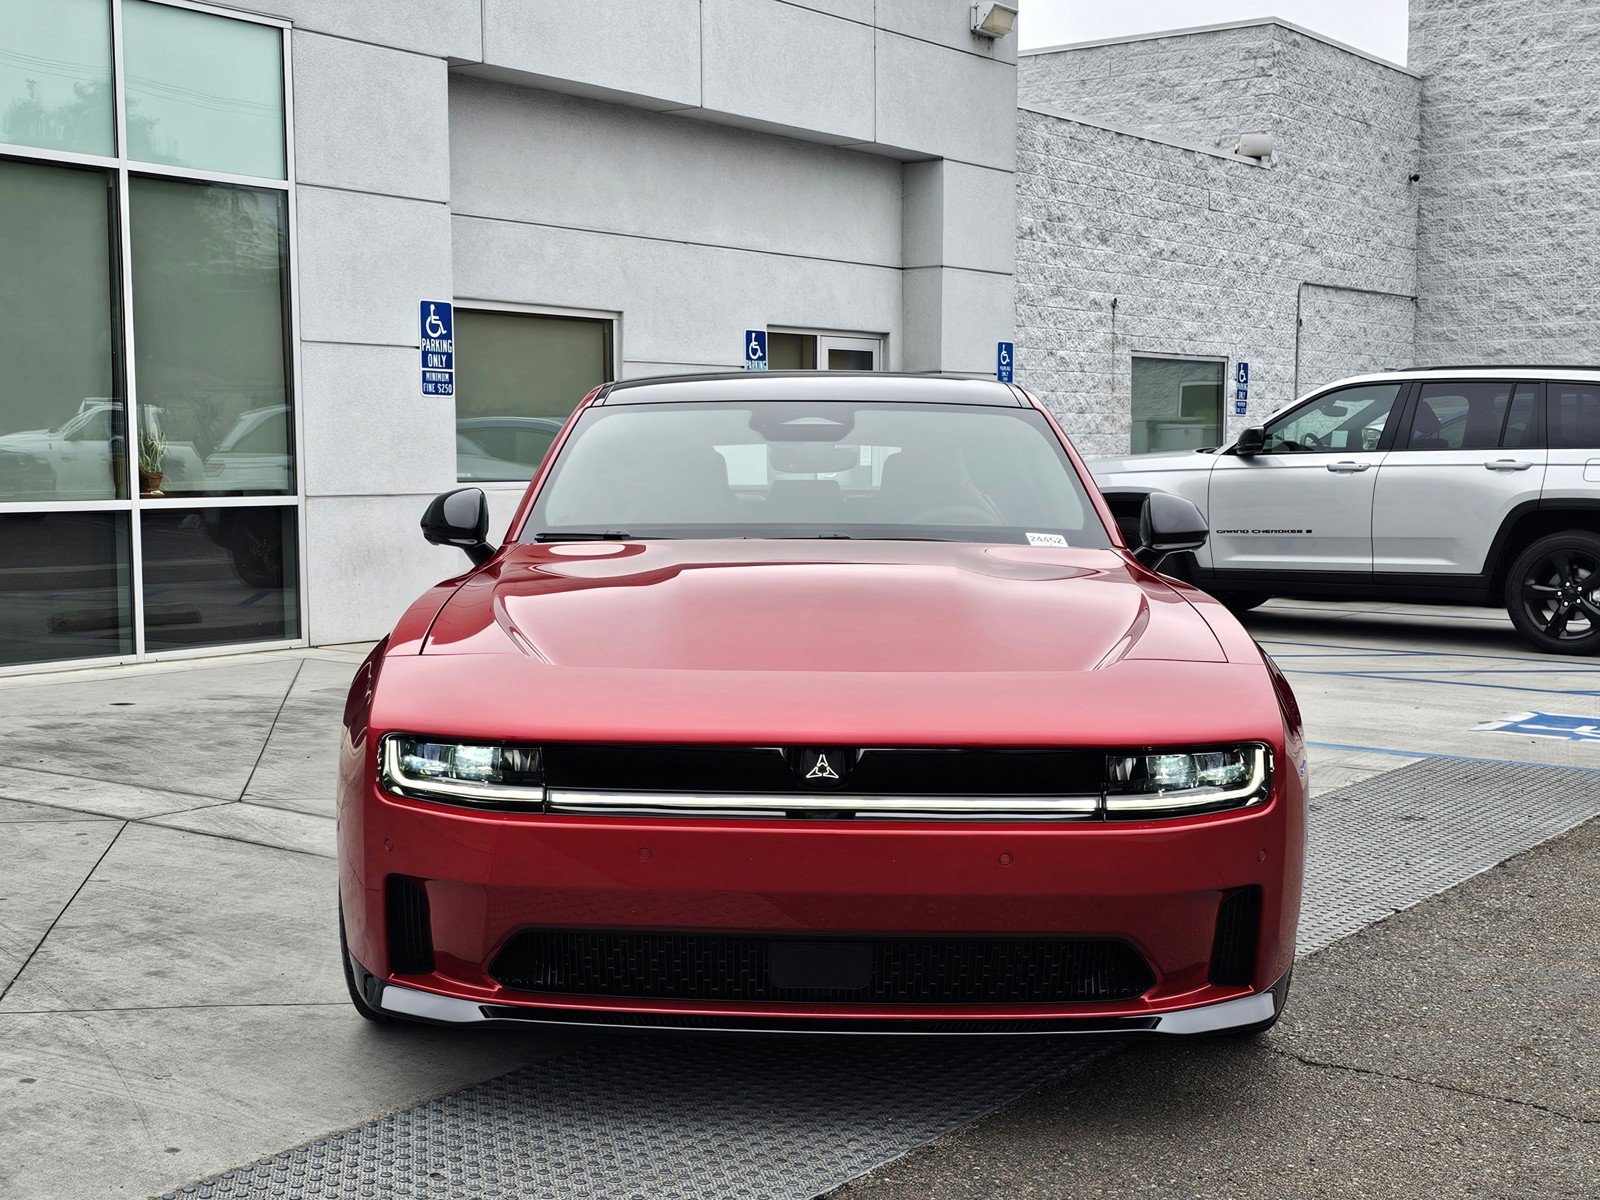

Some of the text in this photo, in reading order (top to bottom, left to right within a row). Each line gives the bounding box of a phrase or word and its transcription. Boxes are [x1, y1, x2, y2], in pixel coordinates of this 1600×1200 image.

[421, 338, 452, 353] PARKING
[427, 353, 447, 368] ONLY
[425, 371, 450, 382] MINIMUM
[423, 382, 453, 394] FINE $250
